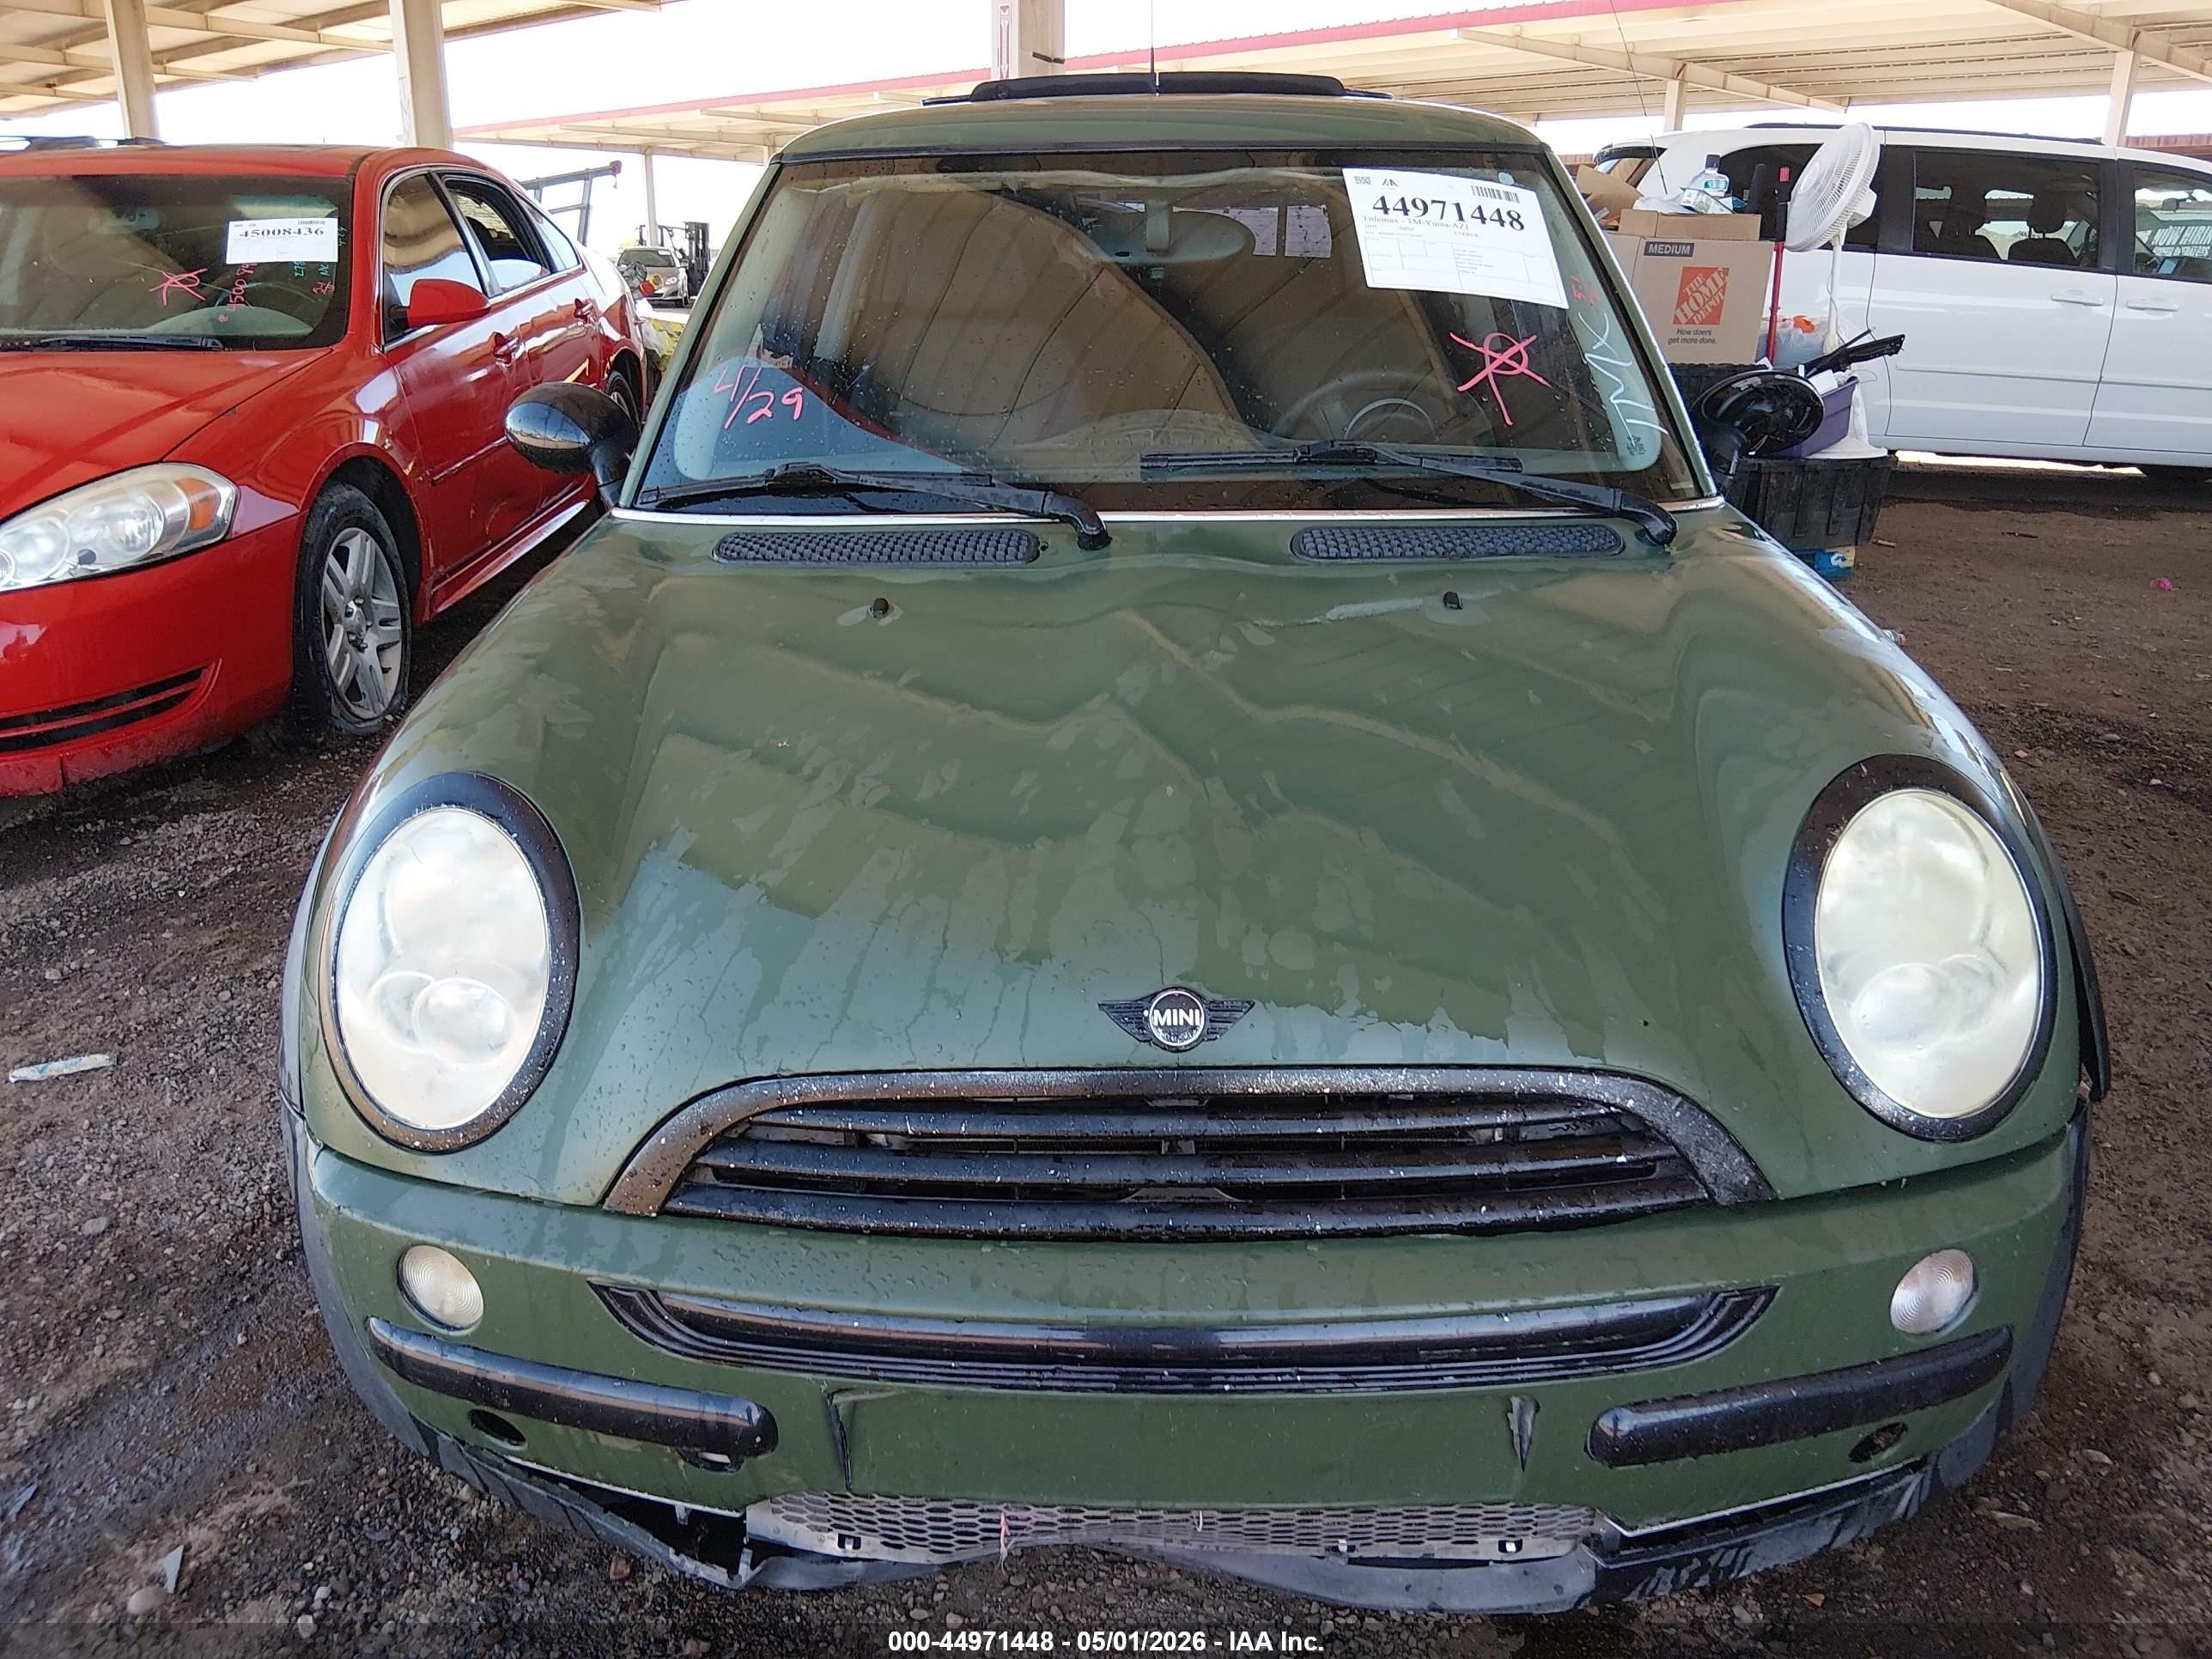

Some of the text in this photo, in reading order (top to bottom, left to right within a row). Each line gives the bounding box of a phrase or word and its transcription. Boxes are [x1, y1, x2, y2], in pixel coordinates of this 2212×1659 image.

[1372, 195, 1525, 231] 44971448
[239, 227, 325, 238] 45008436
[1648, 243, 1691, 255] MEDIUM
[1683, 273, 1705, 296] THE
[1675, 268, 1729, 325] HOME
[1692, 288, 1725, 325] DEPOT
[1668, 337, 1680, 345] get
[714, 363, 804, 429] 4/29
[1152, 1008, 1201, 1026] MINI
